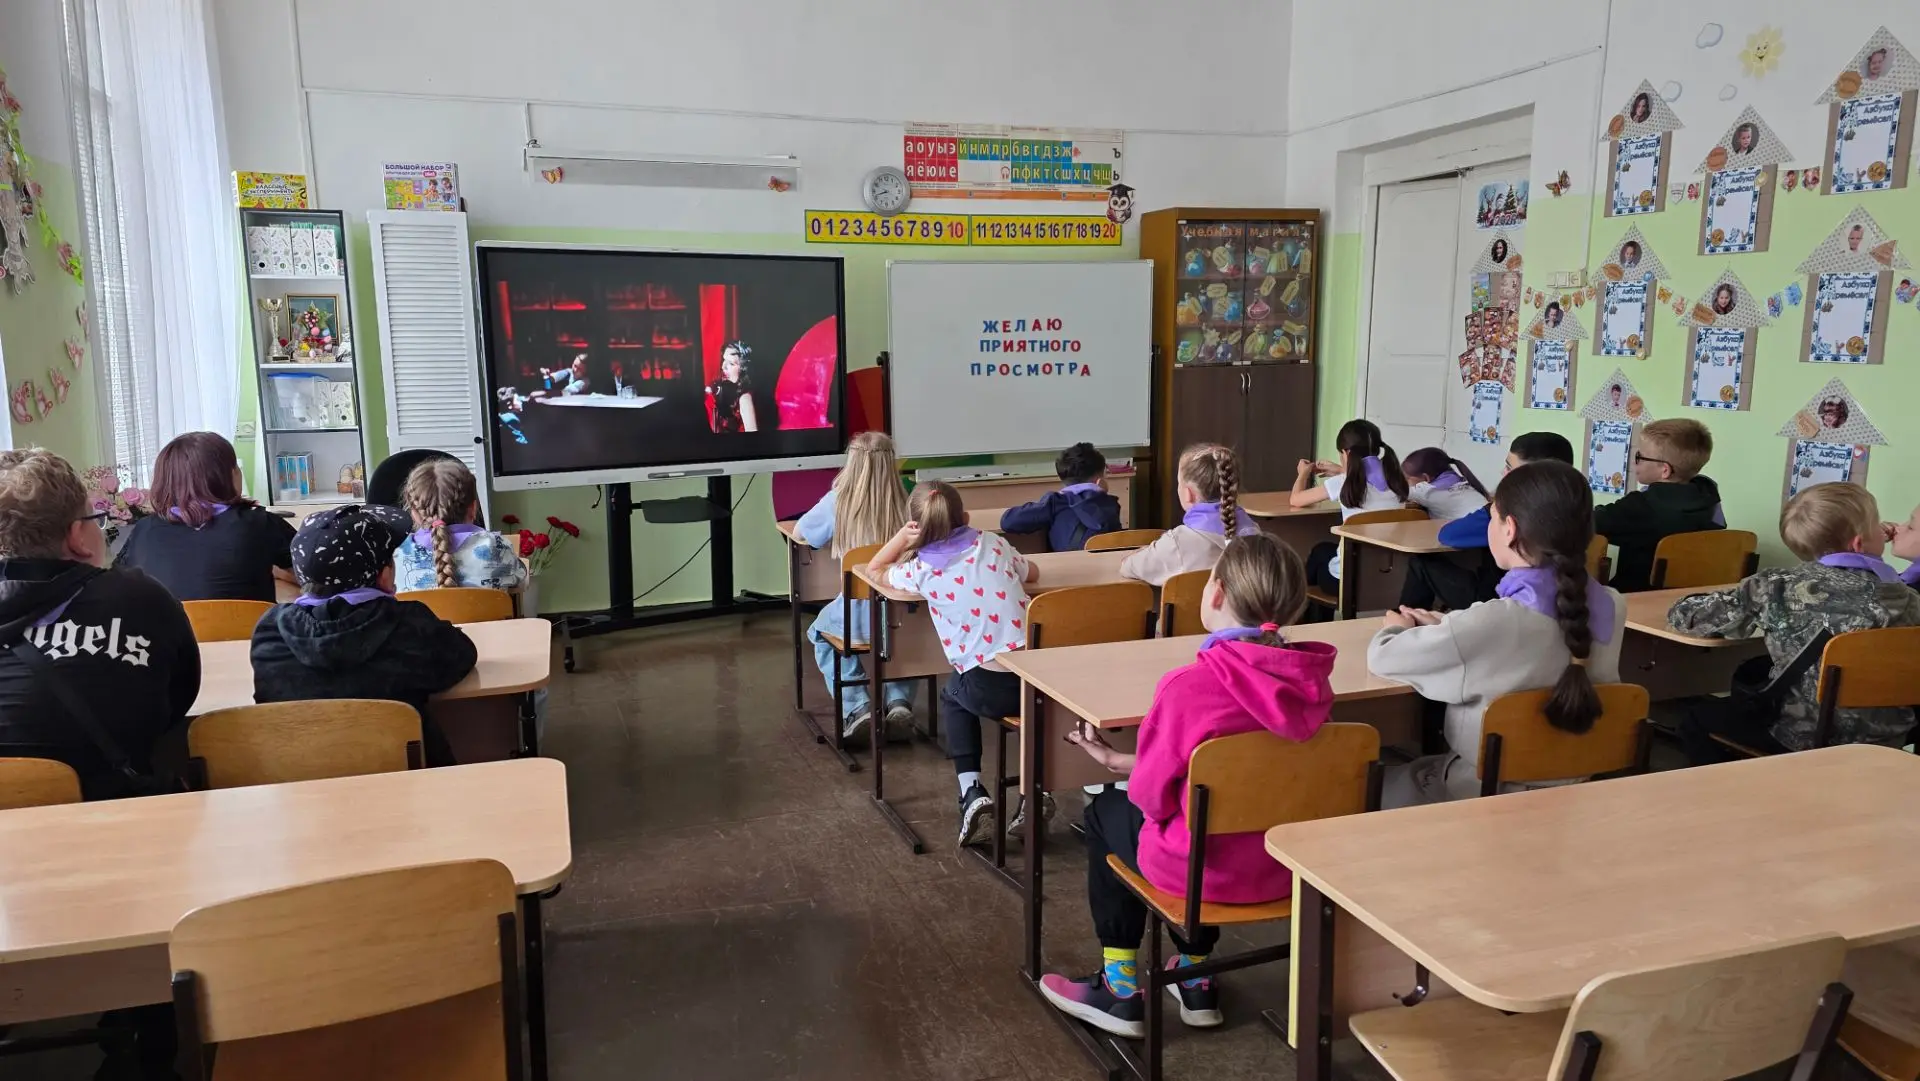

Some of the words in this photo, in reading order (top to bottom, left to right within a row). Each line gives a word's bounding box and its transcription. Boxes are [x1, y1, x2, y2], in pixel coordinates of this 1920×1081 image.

[1864, 103, 1893, 114] Азбука
[811, 218, 821, 235] 0
[825, 218, 833, 236] 1
[839, 219, 849, 236] 2
[853, 219, 863, 236] 3
[866, 219, 877, 237] 4
[880, 220, 891, 237] 5
[894, 220, 904, 237] 6
[907, 220, 917, 237] 7
[920, 220, 930, 238] 8
[933, 221, 943, 238] 9
[947, 221, 964, 239] 10
[976, 223, 987, 238] 11
[989, 223, 1001, 238] 12
[1005, 223, 1017, 238] 13
[1019, 223, 1031, 238] 14
[1034, 223, 1046, 238] 15
[1048, 223, 1060, 238] 16
[1062, 223, 1073, 238] 17
[1076, 223, 1087, 238] 18
[1089, 223, 1101, 238] 19
[1103, 223, 1116, 238] 20
[1841, 280, 1870, 290] Азбука
[982, 318, 1062, 333] ЖЕЛАЮ
[980, 339, 1081, 353] ПРИЯТНОГО
[970, 362, 1091, 376] ПРОСМОТРА
[1819, 450, 1846, 460] Азбука
[23, 618, 151, 667] ngels
